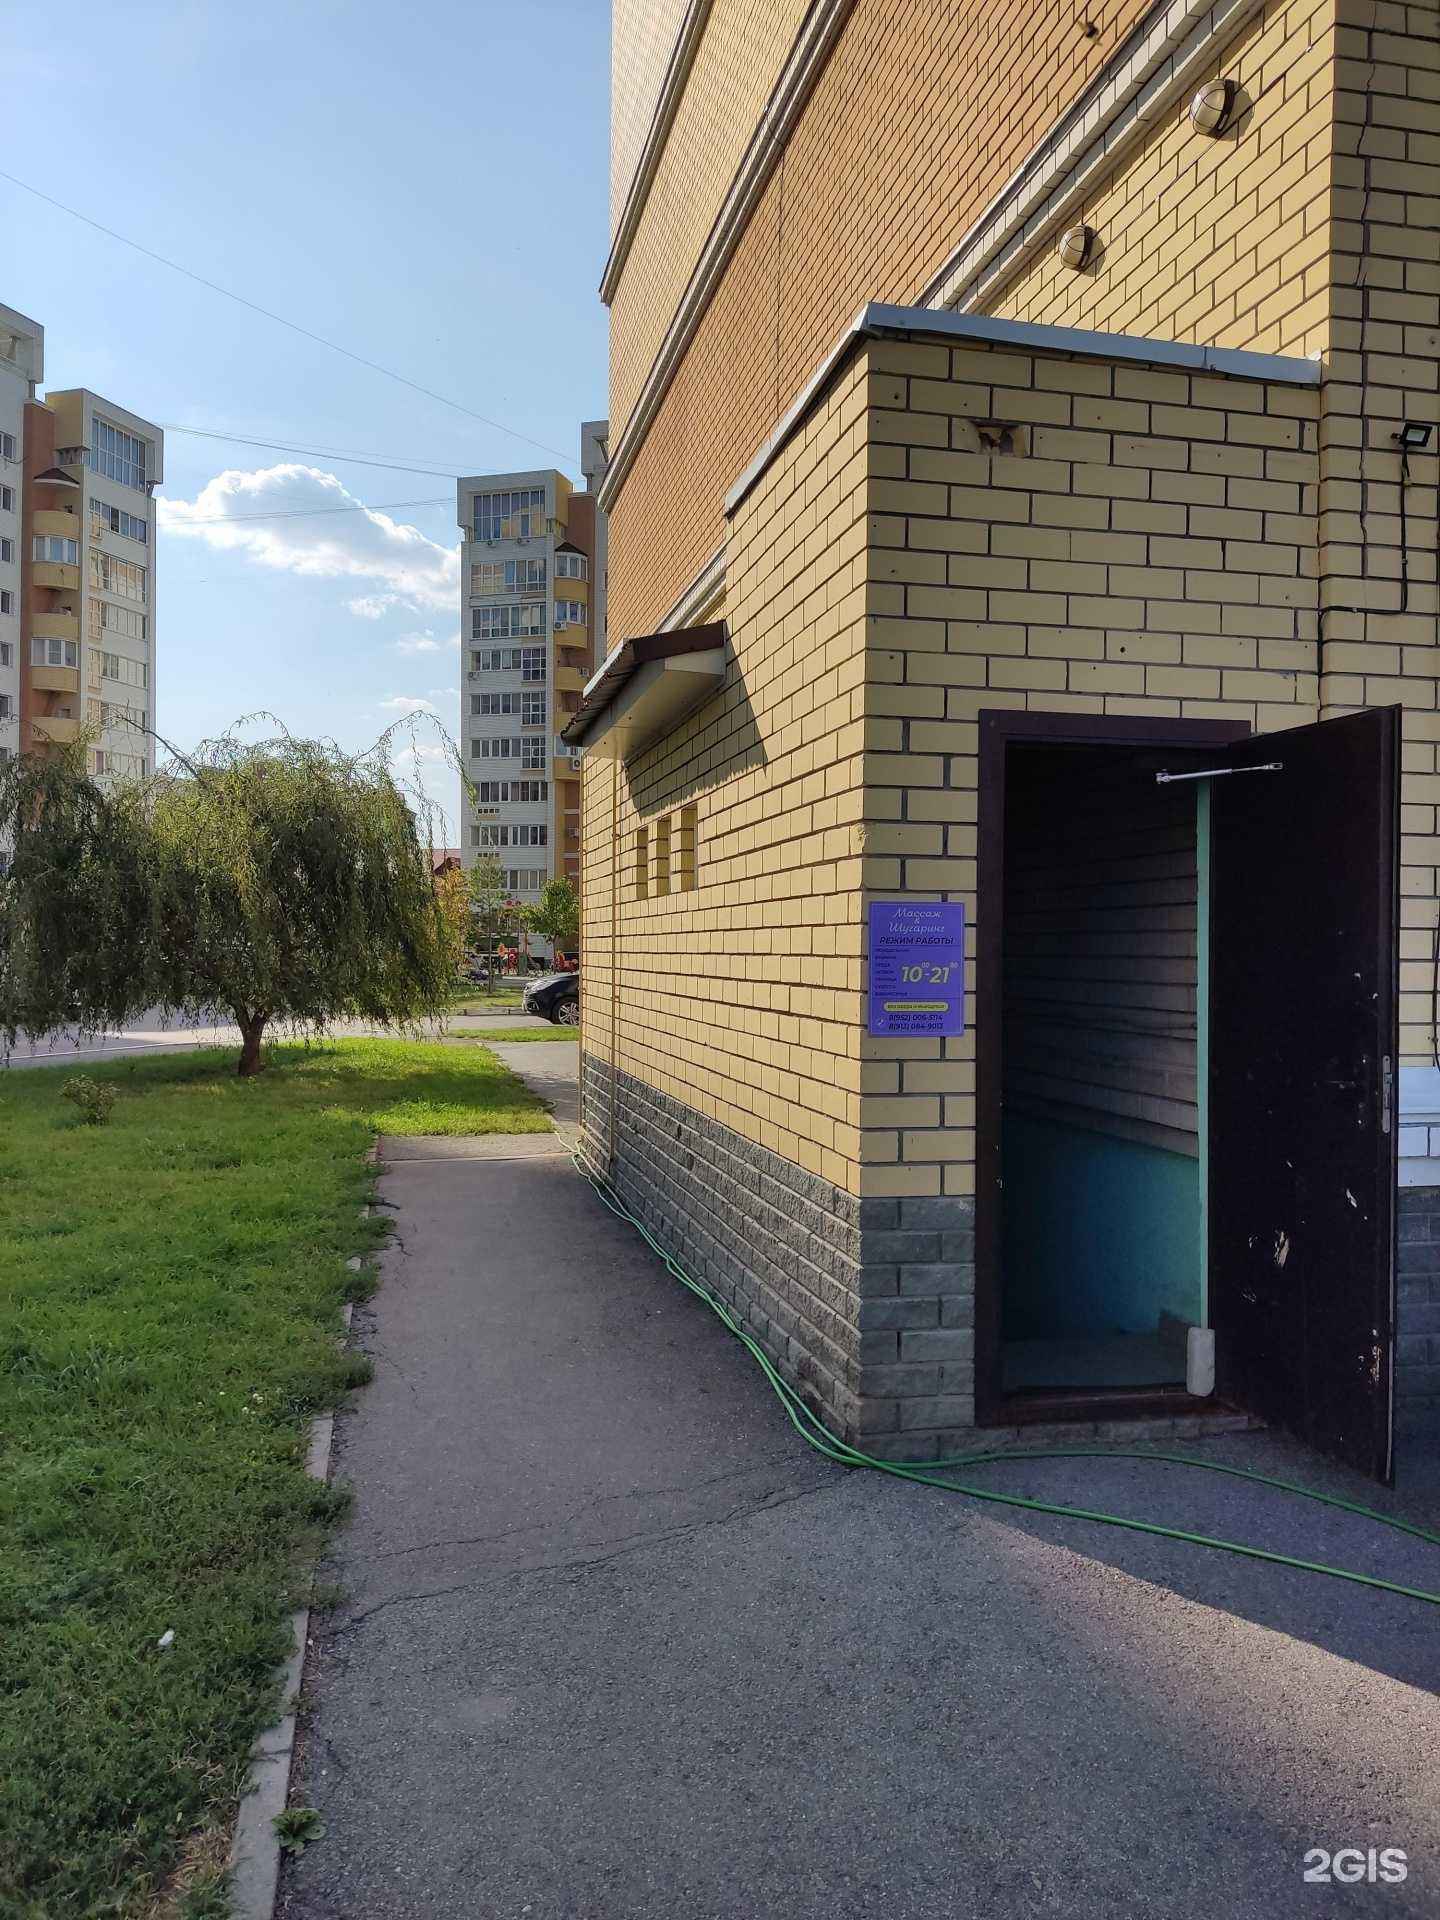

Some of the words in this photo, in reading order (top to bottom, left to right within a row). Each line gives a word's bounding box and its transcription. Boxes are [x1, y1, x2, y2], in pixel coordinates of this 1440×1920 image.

[893, 907, 942, 919] Массаж
[879, 936, 914, 945] РЕЖИМ
[914, 936, 954, 945] РАБОТЫ
